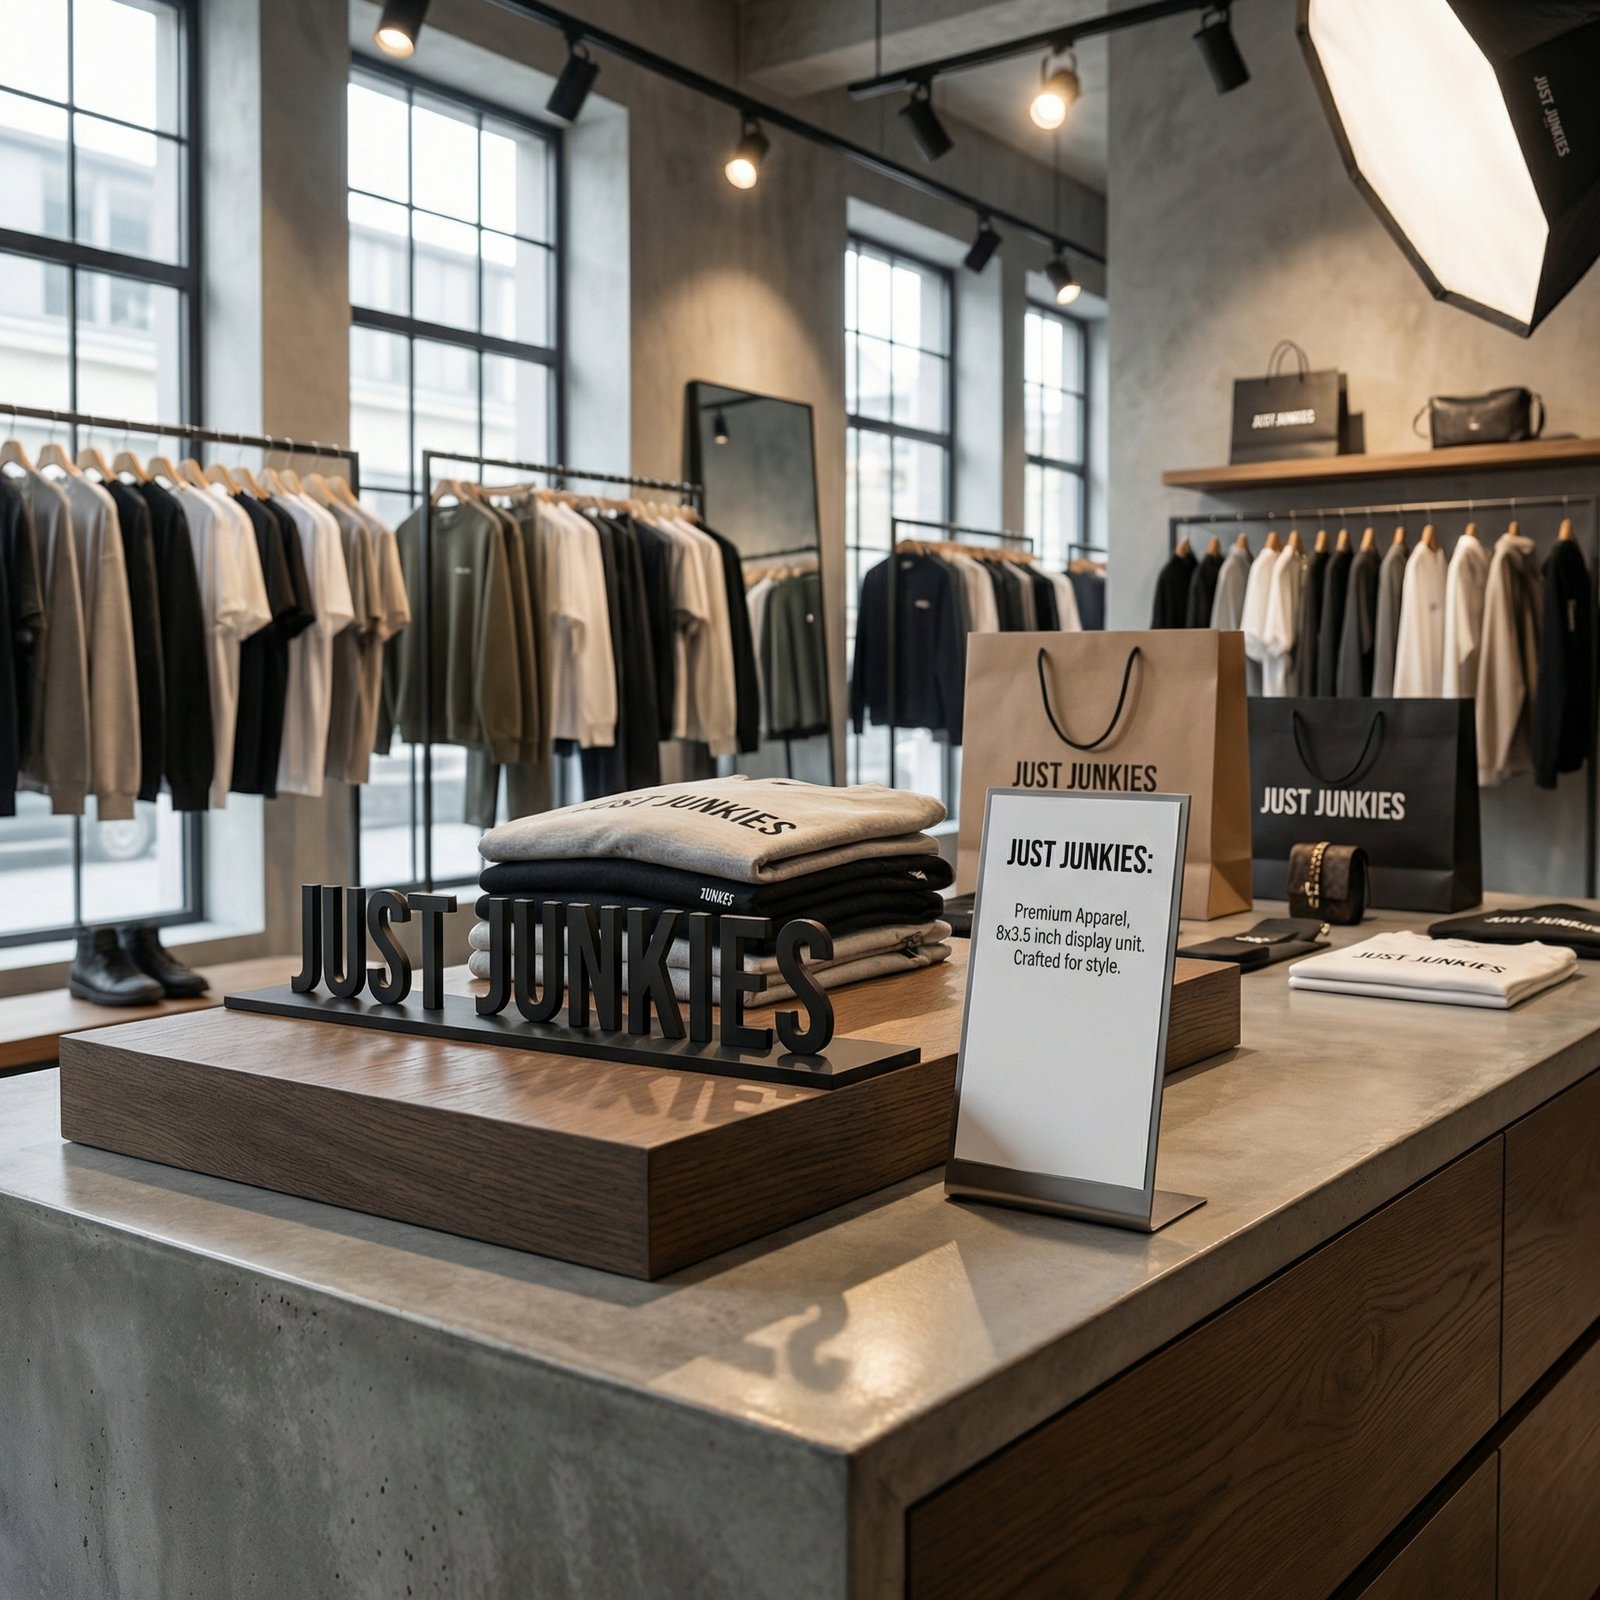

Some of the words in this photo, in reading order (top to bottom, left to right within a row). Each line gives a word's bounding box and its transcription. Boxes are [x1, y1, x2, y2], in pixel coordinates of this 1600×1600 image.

[1533, 75, 1555, 105] JUST
[1544, 108, 1571, 157] JUNKIES
[1012, 761, 1062, 789] JUST
[1067, 763, 1158, 792] JUNKIES
[652, 794, 797, 837] JUNKIES
[1260, 786, 1311, 816] JUST
[1314, 789, 1406, 821] JUNKIES
[1006, 838, 1057, 868] JUST
[1059, 841, 1154, 874] JUNKIES:
[1014, 903, 1072, 923] Premium
[1075, 907, 1131, 929] Apparel,
[996, 924, 1032, 943] 8x3.5
[1034, 927, 1062, 945] inch
[1065, 930, 1112, 953] display
[1115, 935, 1145, 953] unit.
[291, 883, 457, 1010] JUST
[475, 897, 835, 1055] JUNKIES
[1013, 949, 1061, 969] Crafted
[1064, 953, 1083, 971] for
[1085, 955, 1121, 977] style.
[1352, 951, 1408, 961] JUST
[1409, 955, 1507, 974] JUNKIES
